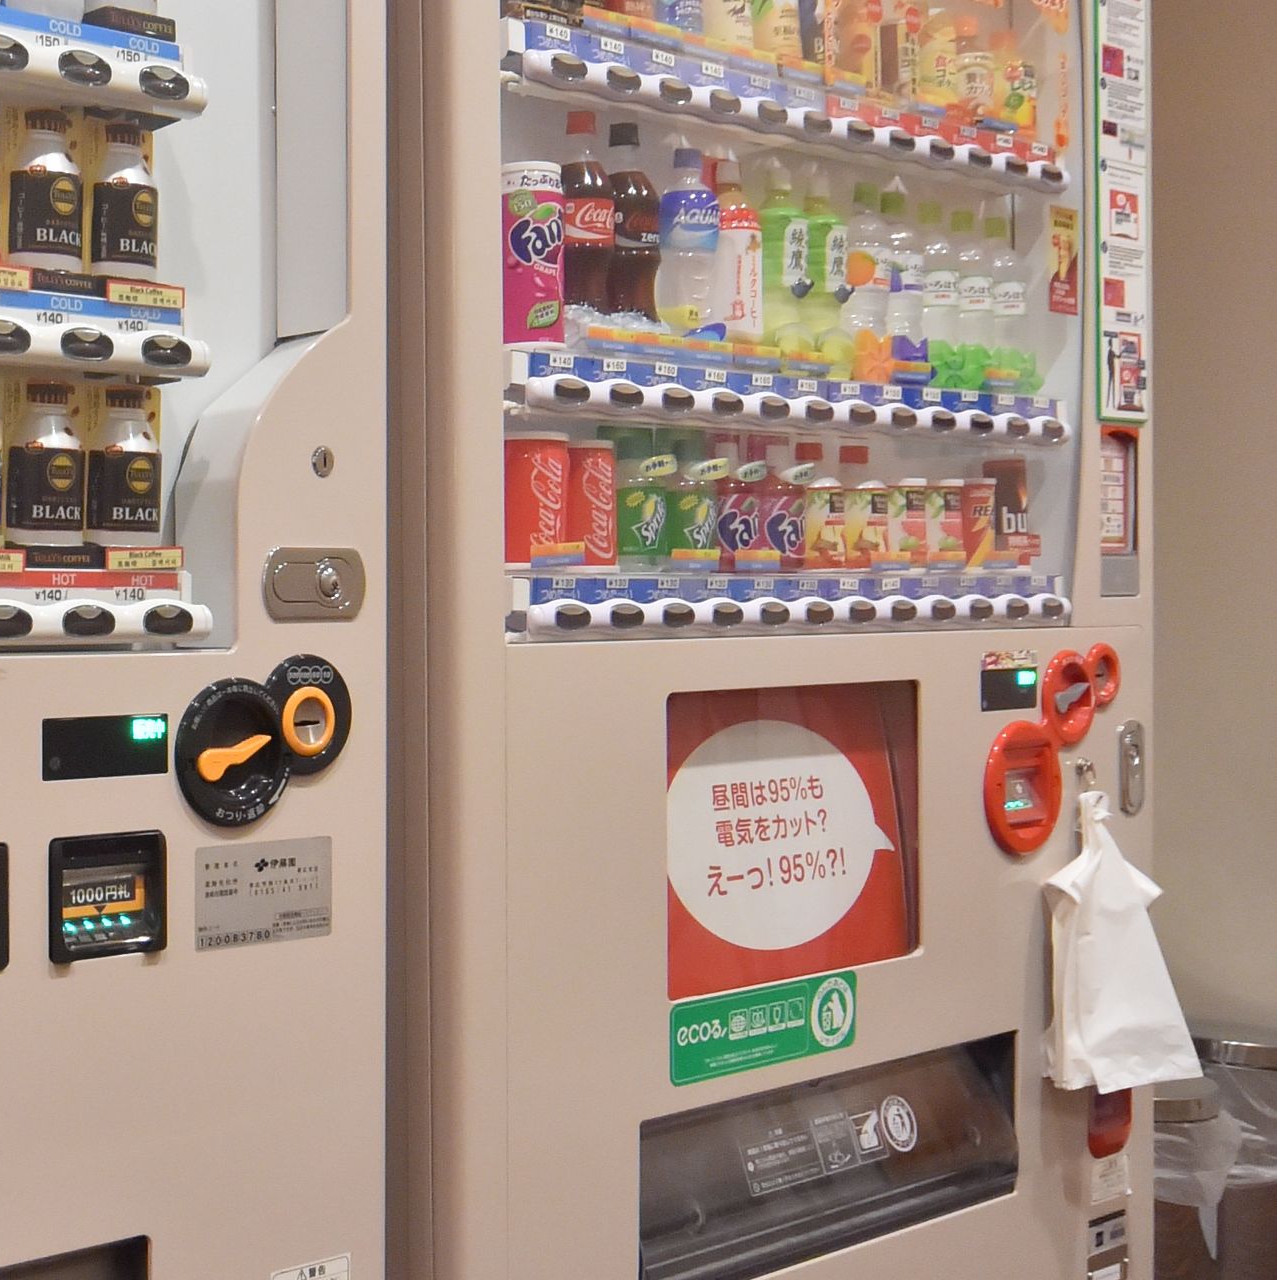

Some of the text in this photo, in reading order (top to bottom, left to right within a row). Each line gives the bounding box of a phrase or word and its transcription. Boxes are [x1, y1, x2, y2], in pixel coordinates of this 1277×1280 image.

[49, 20, 82, 37] COLD
[128, 37, 160, 53] COLD
[36, 228, 82, 248] BLACK
[50, 297, 83, 312] COLD
[31, 504, 82, 520] BLACK
[112, 507, 159, 522] BLACK
[582, 459, 614, 560] Coca-Cola
[52, 573, 76, 585] HOT
[131, 574, 155, 586] HOT
[712, 774, 824, 812] 昼間は95%も
[715, 808, 828, 848] 電気をカット?
[71, 885, 131, 905] 1000円札
